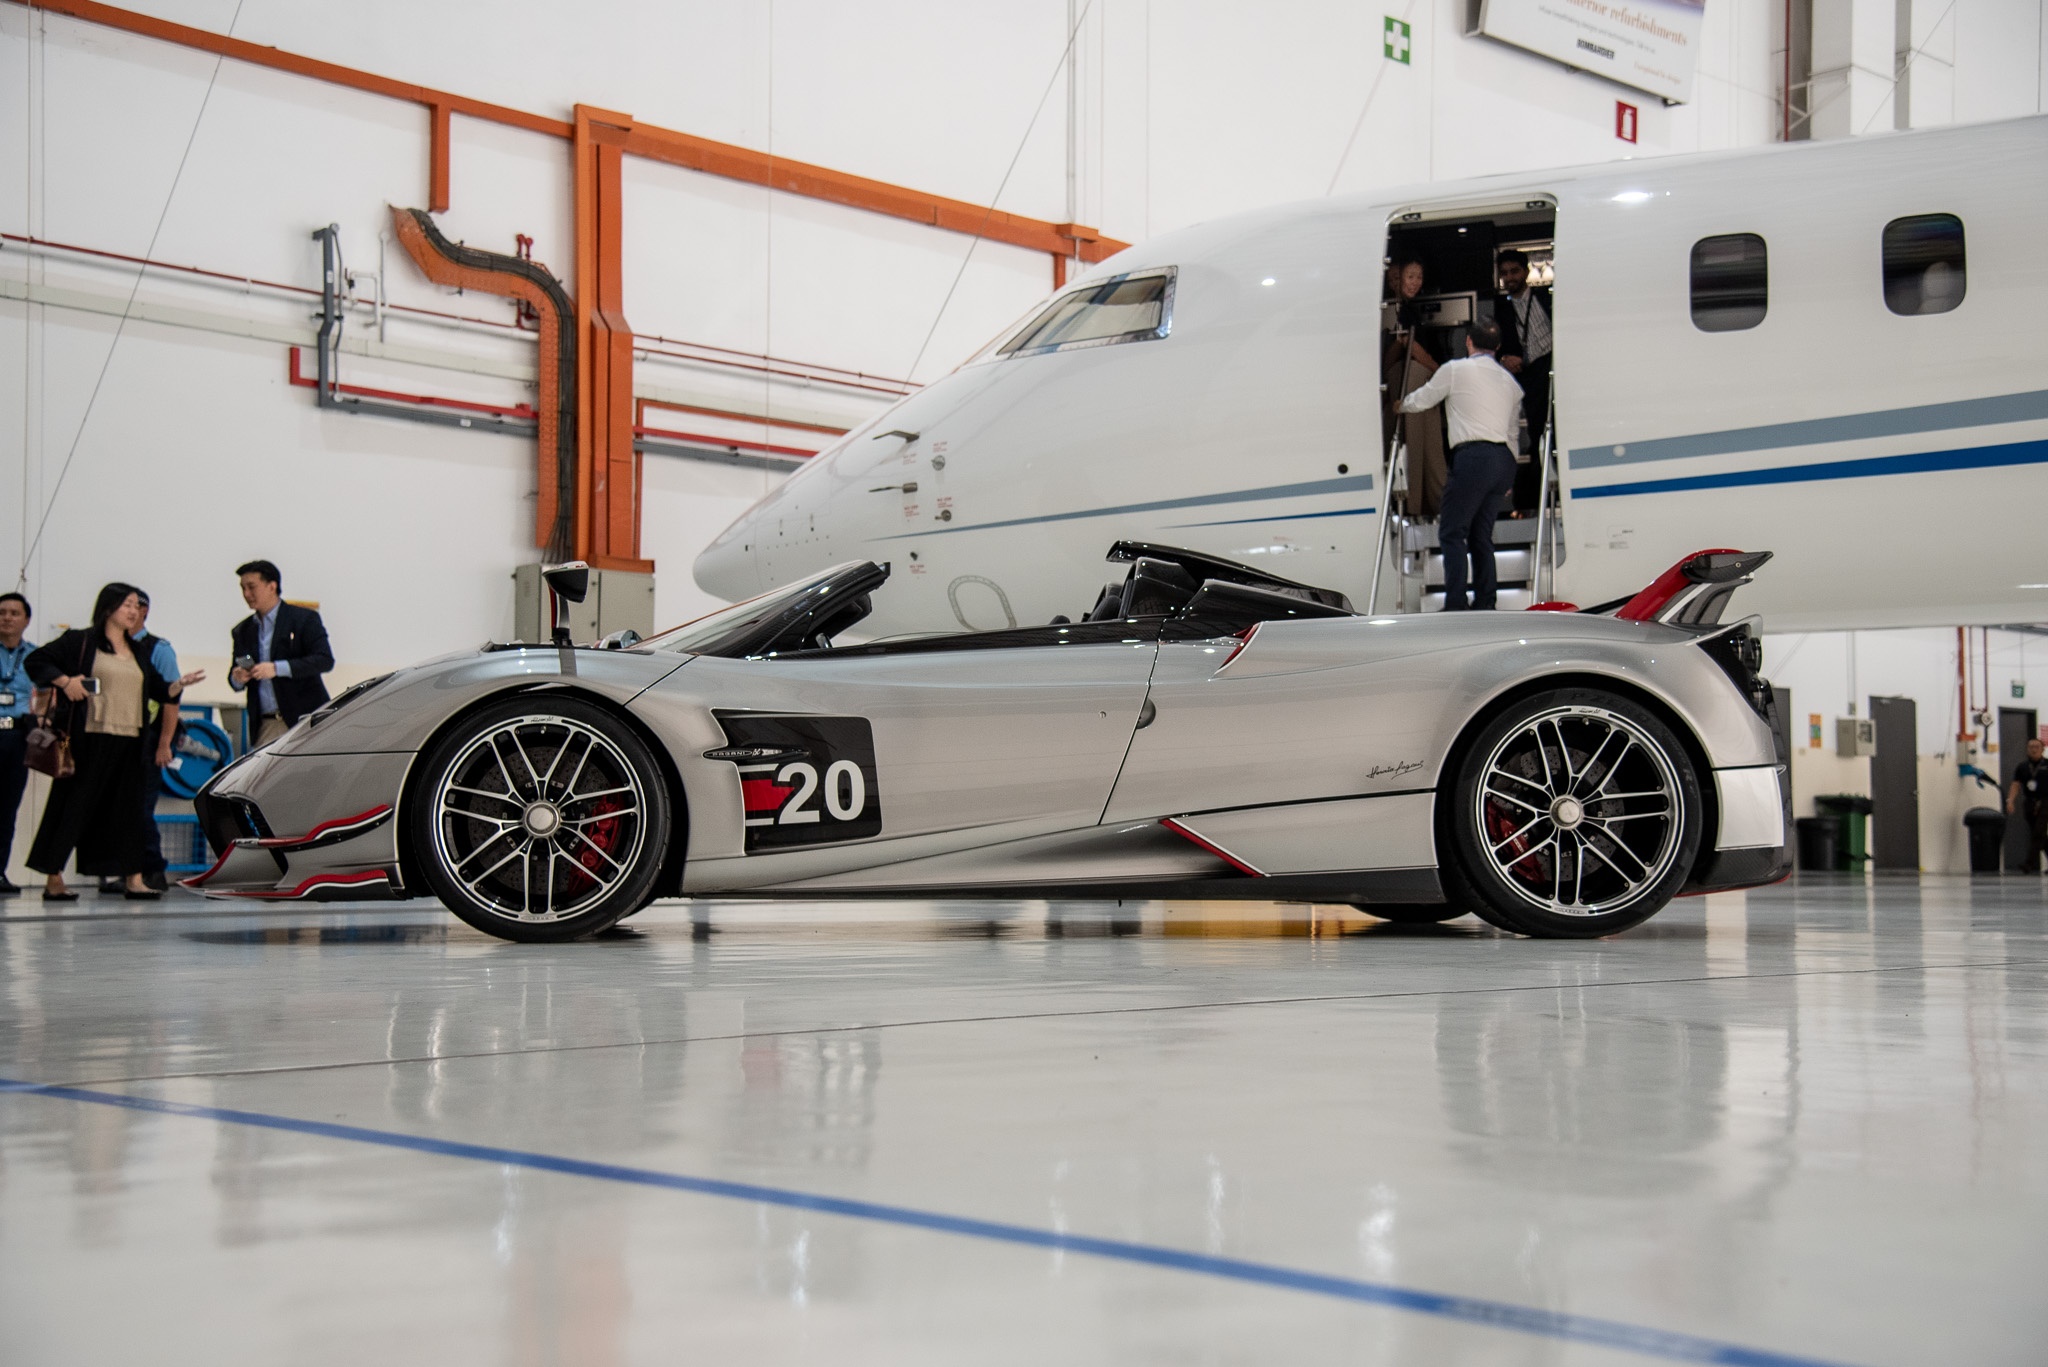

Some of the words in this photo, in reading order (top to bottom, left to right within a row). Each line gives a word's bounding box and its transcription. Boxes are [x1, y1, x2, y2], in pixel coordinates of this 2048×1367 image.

[1609, 6, 1687, 46] refurbishments
[1576, 38, 1615, 60] BOMBARDIER
[778, 760, 865, 824] 20
